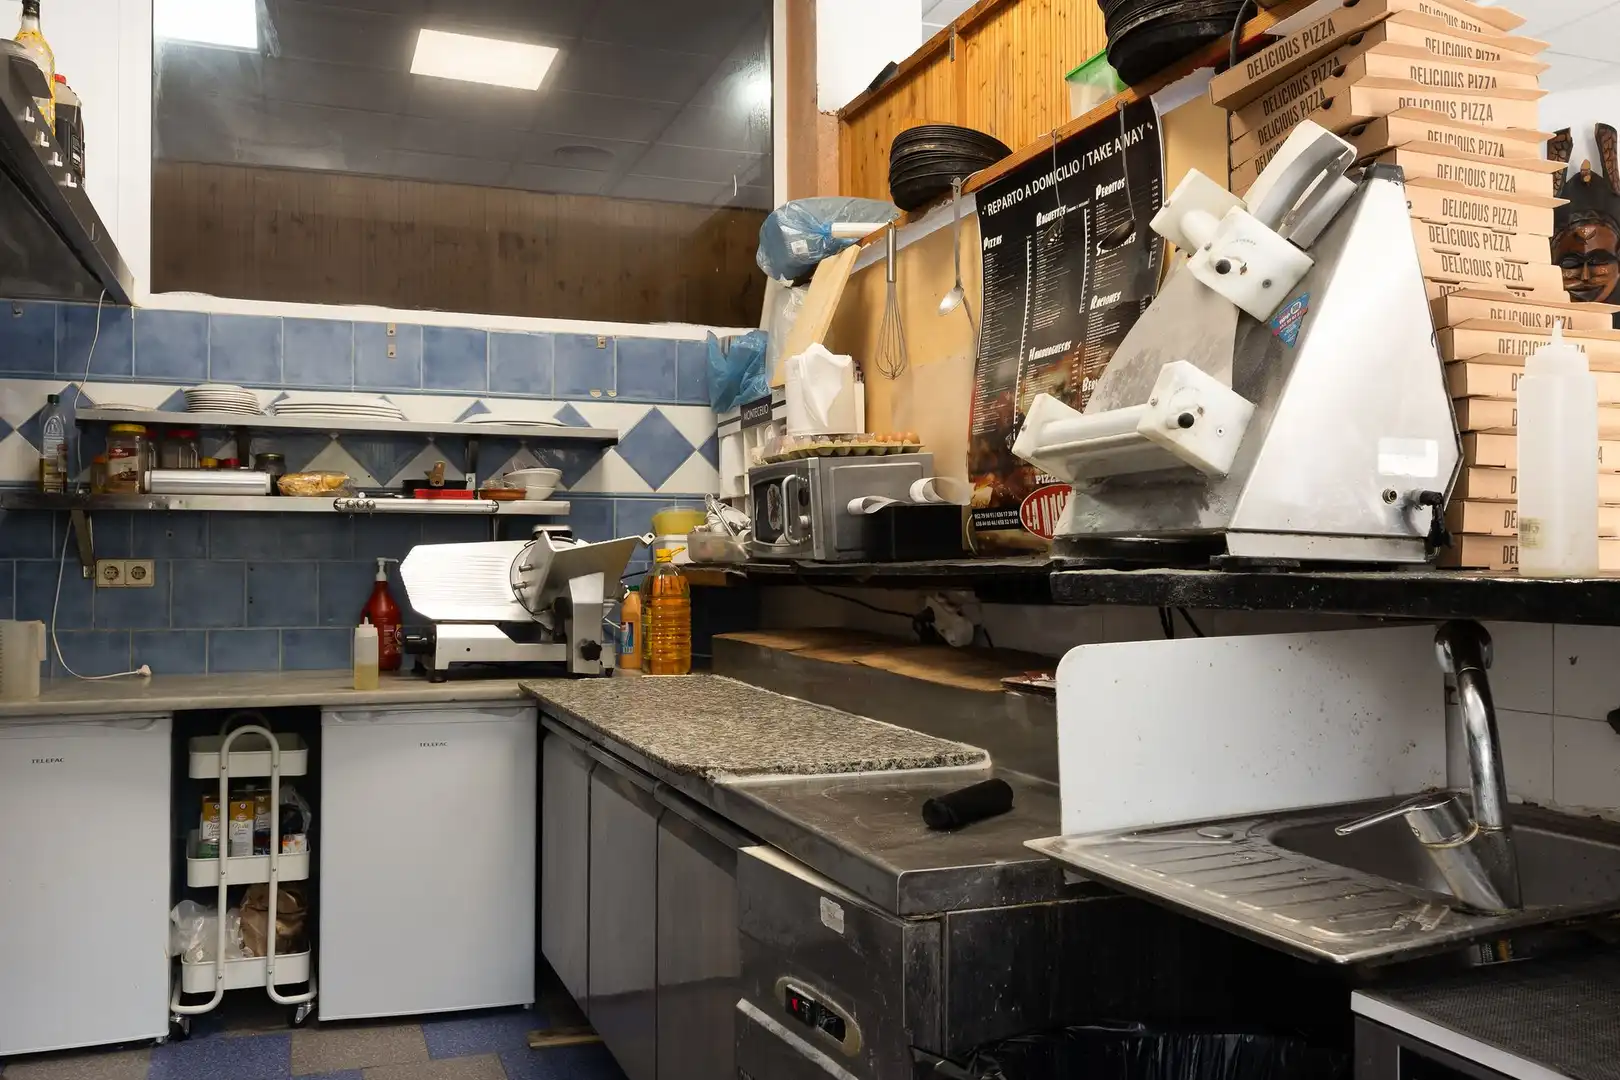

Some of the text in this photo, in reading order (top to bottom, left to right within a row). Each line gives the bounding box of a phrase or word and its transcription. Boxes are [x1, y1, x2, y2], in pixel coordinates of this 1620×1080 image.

[1246, 17, 1336, 80] DELICIOUS PIZZA
[1410, 65, 1497, 90] DELICIOUS PIZZA
[1263, 74, 1311, 117] DELICIOUS
[1257, 86, 1327, 147] DELICIOUS PIZZA
[1461, 102, 1494, 122] PIZZA
[1478, 139, 1505, 158] PIZZA
[987, 187, 1024, 217] REPARTO
[1025, 182, 1032, 198] A
[1032, 159, 1080, 194] DOMICILIO
[1087, 143, 1113, 167] TAKE
[1114, 124, 1145, 153] AWAY
[1437, 164, 1516, 194] DELICIOUS PIZZA
[1095, 177, 1126, 201] PERRITOS
[1442, 198, 1518, 228] DELICIOUS PIZZA
[983, 234, 1003, 251] PIZZAS
[1428, 226, 1512, 253] DELICIOUS PIZZA
[1441, 255, 1524, 282] DELICIOUS PIZZA
[1089, 290, 1122, 311] RACIONES
